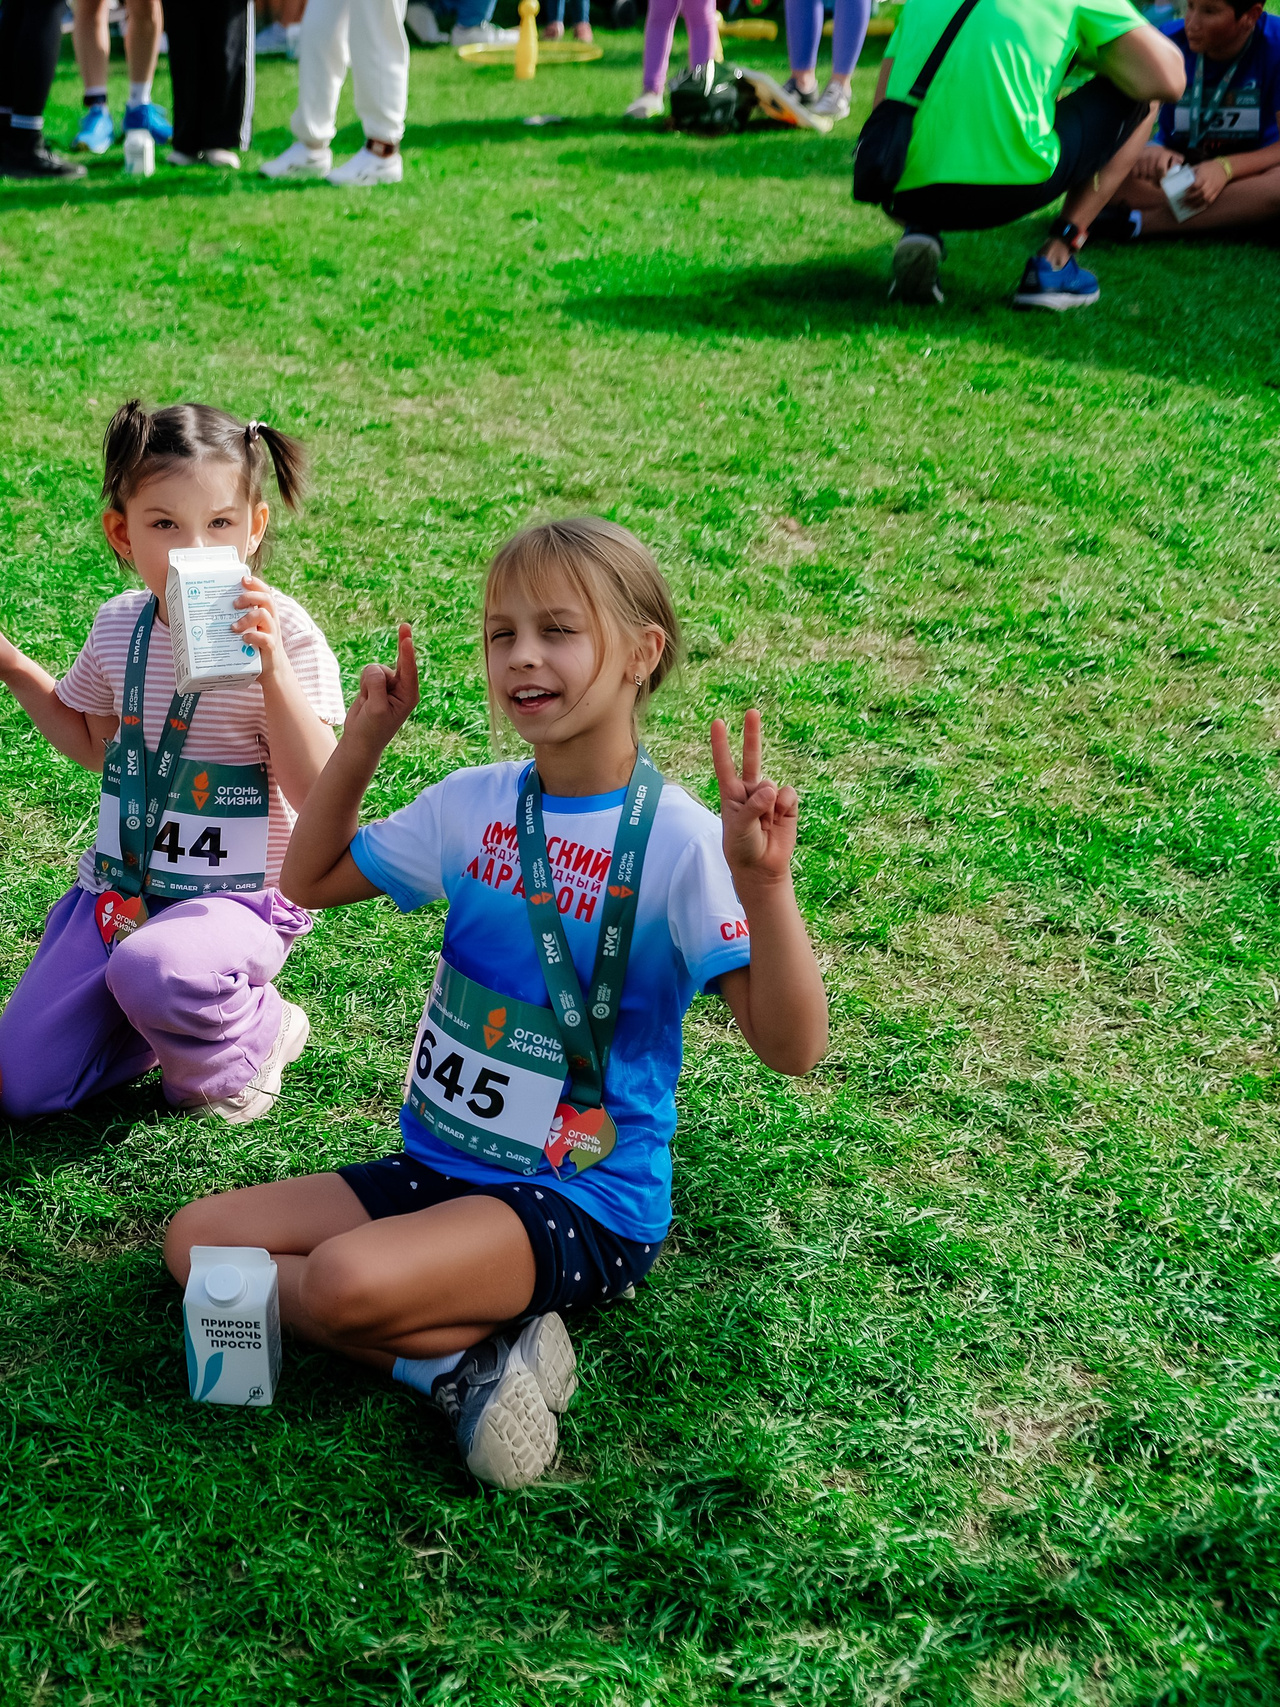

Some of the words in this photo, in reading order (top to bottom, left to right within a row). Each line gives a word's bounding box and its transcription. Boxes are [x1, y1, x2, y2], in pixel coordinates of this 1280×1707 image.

[133, 625, 145, 656] MAER
[214, 795, 262, 806] ЖИЗНИ
[216, 786, 259, 795] ОГОНЬ
[631, 784, 648, 817] MAER
[525, 793, 535, 826] MAER
[153, 820, 228, 867] 44
[532, 861, 541, 889] ОГОНЬ
[536, 857, 548, 889] ЖИЗНИ
[617, 852, 628, 880] ОГОНЬ
[624, 850, 635, 883] ЖИЗНИ
[115, 913, 138, 928] ОГОНЬ
[453, 1015, 471, 1030] ЗАБЕГ
[506, 1037, 564, 1064] ЖИЗНИ
[513, 1028, 563, 1051] ОГОНЬ
[416, 1029, 511, 1119] 645
[442, 1125, 465, 1141] MAER
[567, 1129, 601, 1146] ОГОНЬ
[562, 1136, 602, 1155] ЖИЗНИ
[505, 1150, 532, 1166] DARS
[205, 1329, 262, 1340] ПОМОЧЬ
[210, 1339, 262, 1350] ПРОСТО
